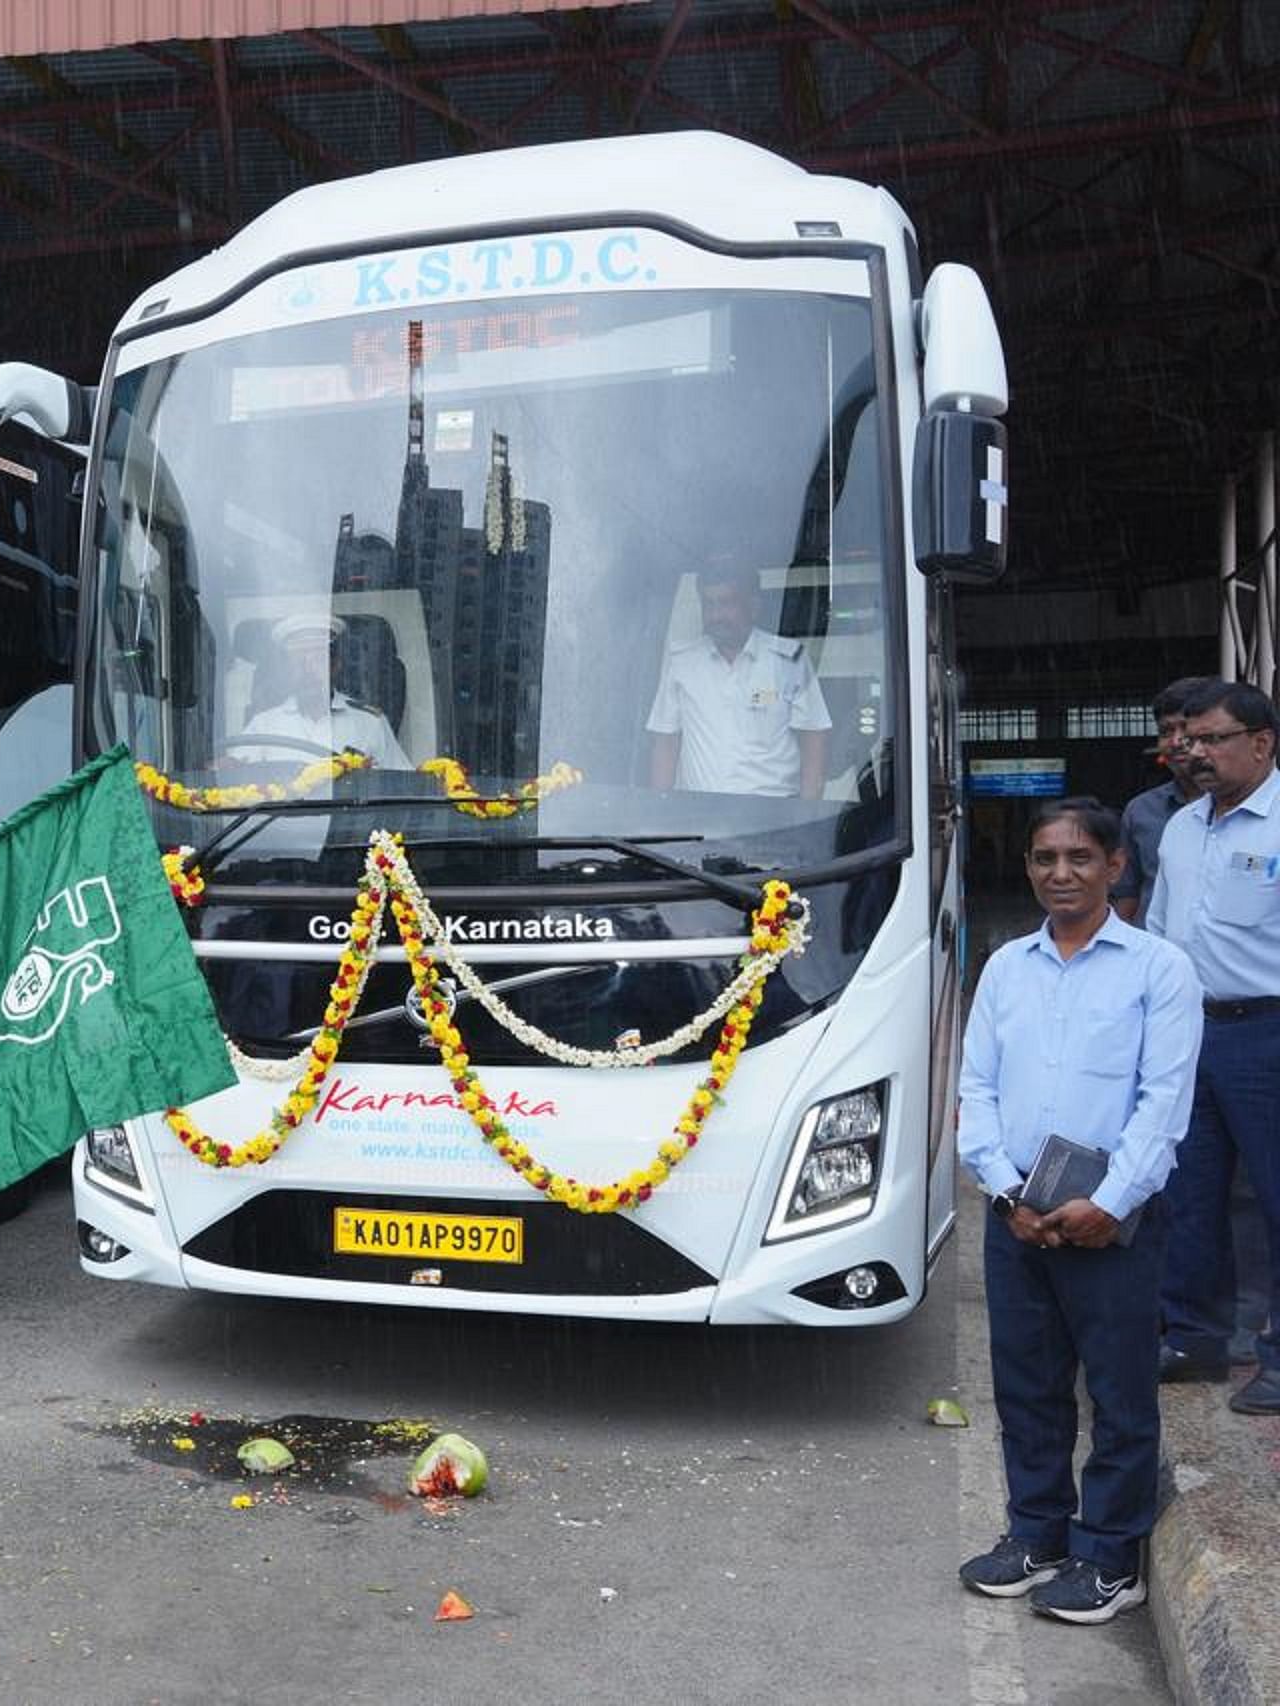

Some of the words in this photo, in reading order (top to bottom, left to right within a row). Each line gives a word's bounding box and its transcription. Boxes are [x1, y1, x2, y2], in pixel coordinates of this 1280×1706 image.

[354, 234, 658, 306] K.S.T.D.C.
[445, 912, 616, 940] Karnataka
[354, 1218, 517, 1254] KA01AP9970
